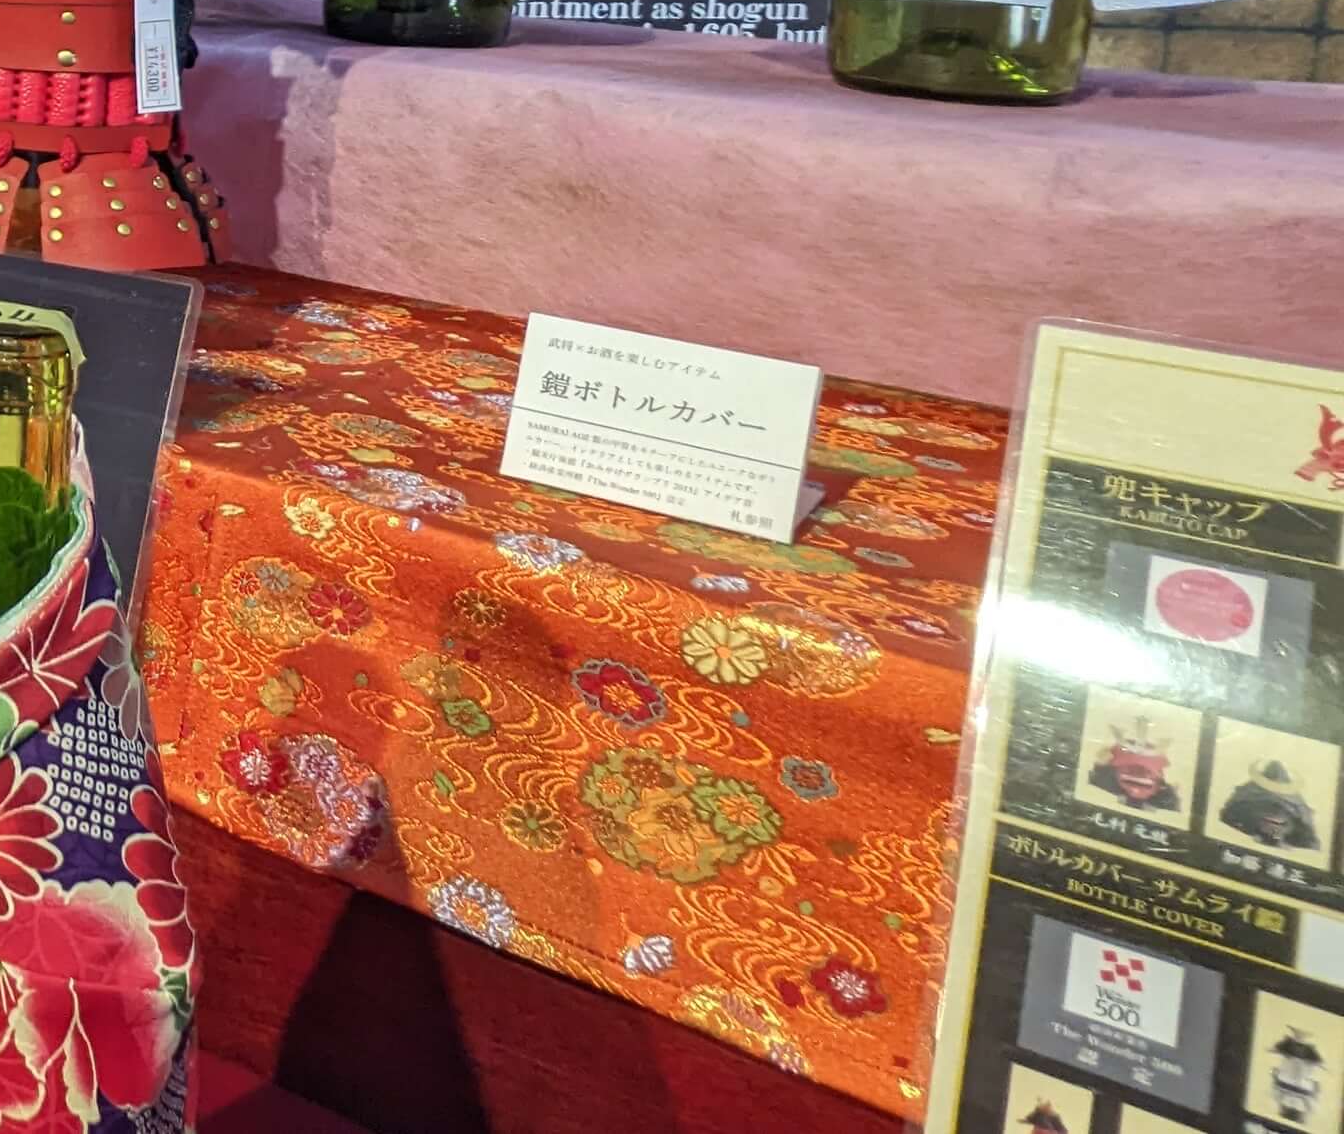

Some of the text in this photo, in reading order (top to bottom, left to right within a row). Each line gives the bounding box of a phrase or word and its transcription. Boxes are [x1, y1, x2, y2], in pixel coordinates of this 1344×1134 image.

[650, 1, 686, 20] as
[146, 45, 161, 94] ¥14300
[547, 336, 722, 381] 武将×お酒を楽しむアイテム
[539, 369, 767, 432] 鎧ボトルカバー
[1103, 473, 1270, 523] 兜キャップ
[1118, 503, 1249, 543] KABUTO CAP
[1007, 832, 1145, 886] ボトルカバー
[1065, 877, 1228, 940] BOTTLE COVER
[1094, 997, 1141, 1028] 500
